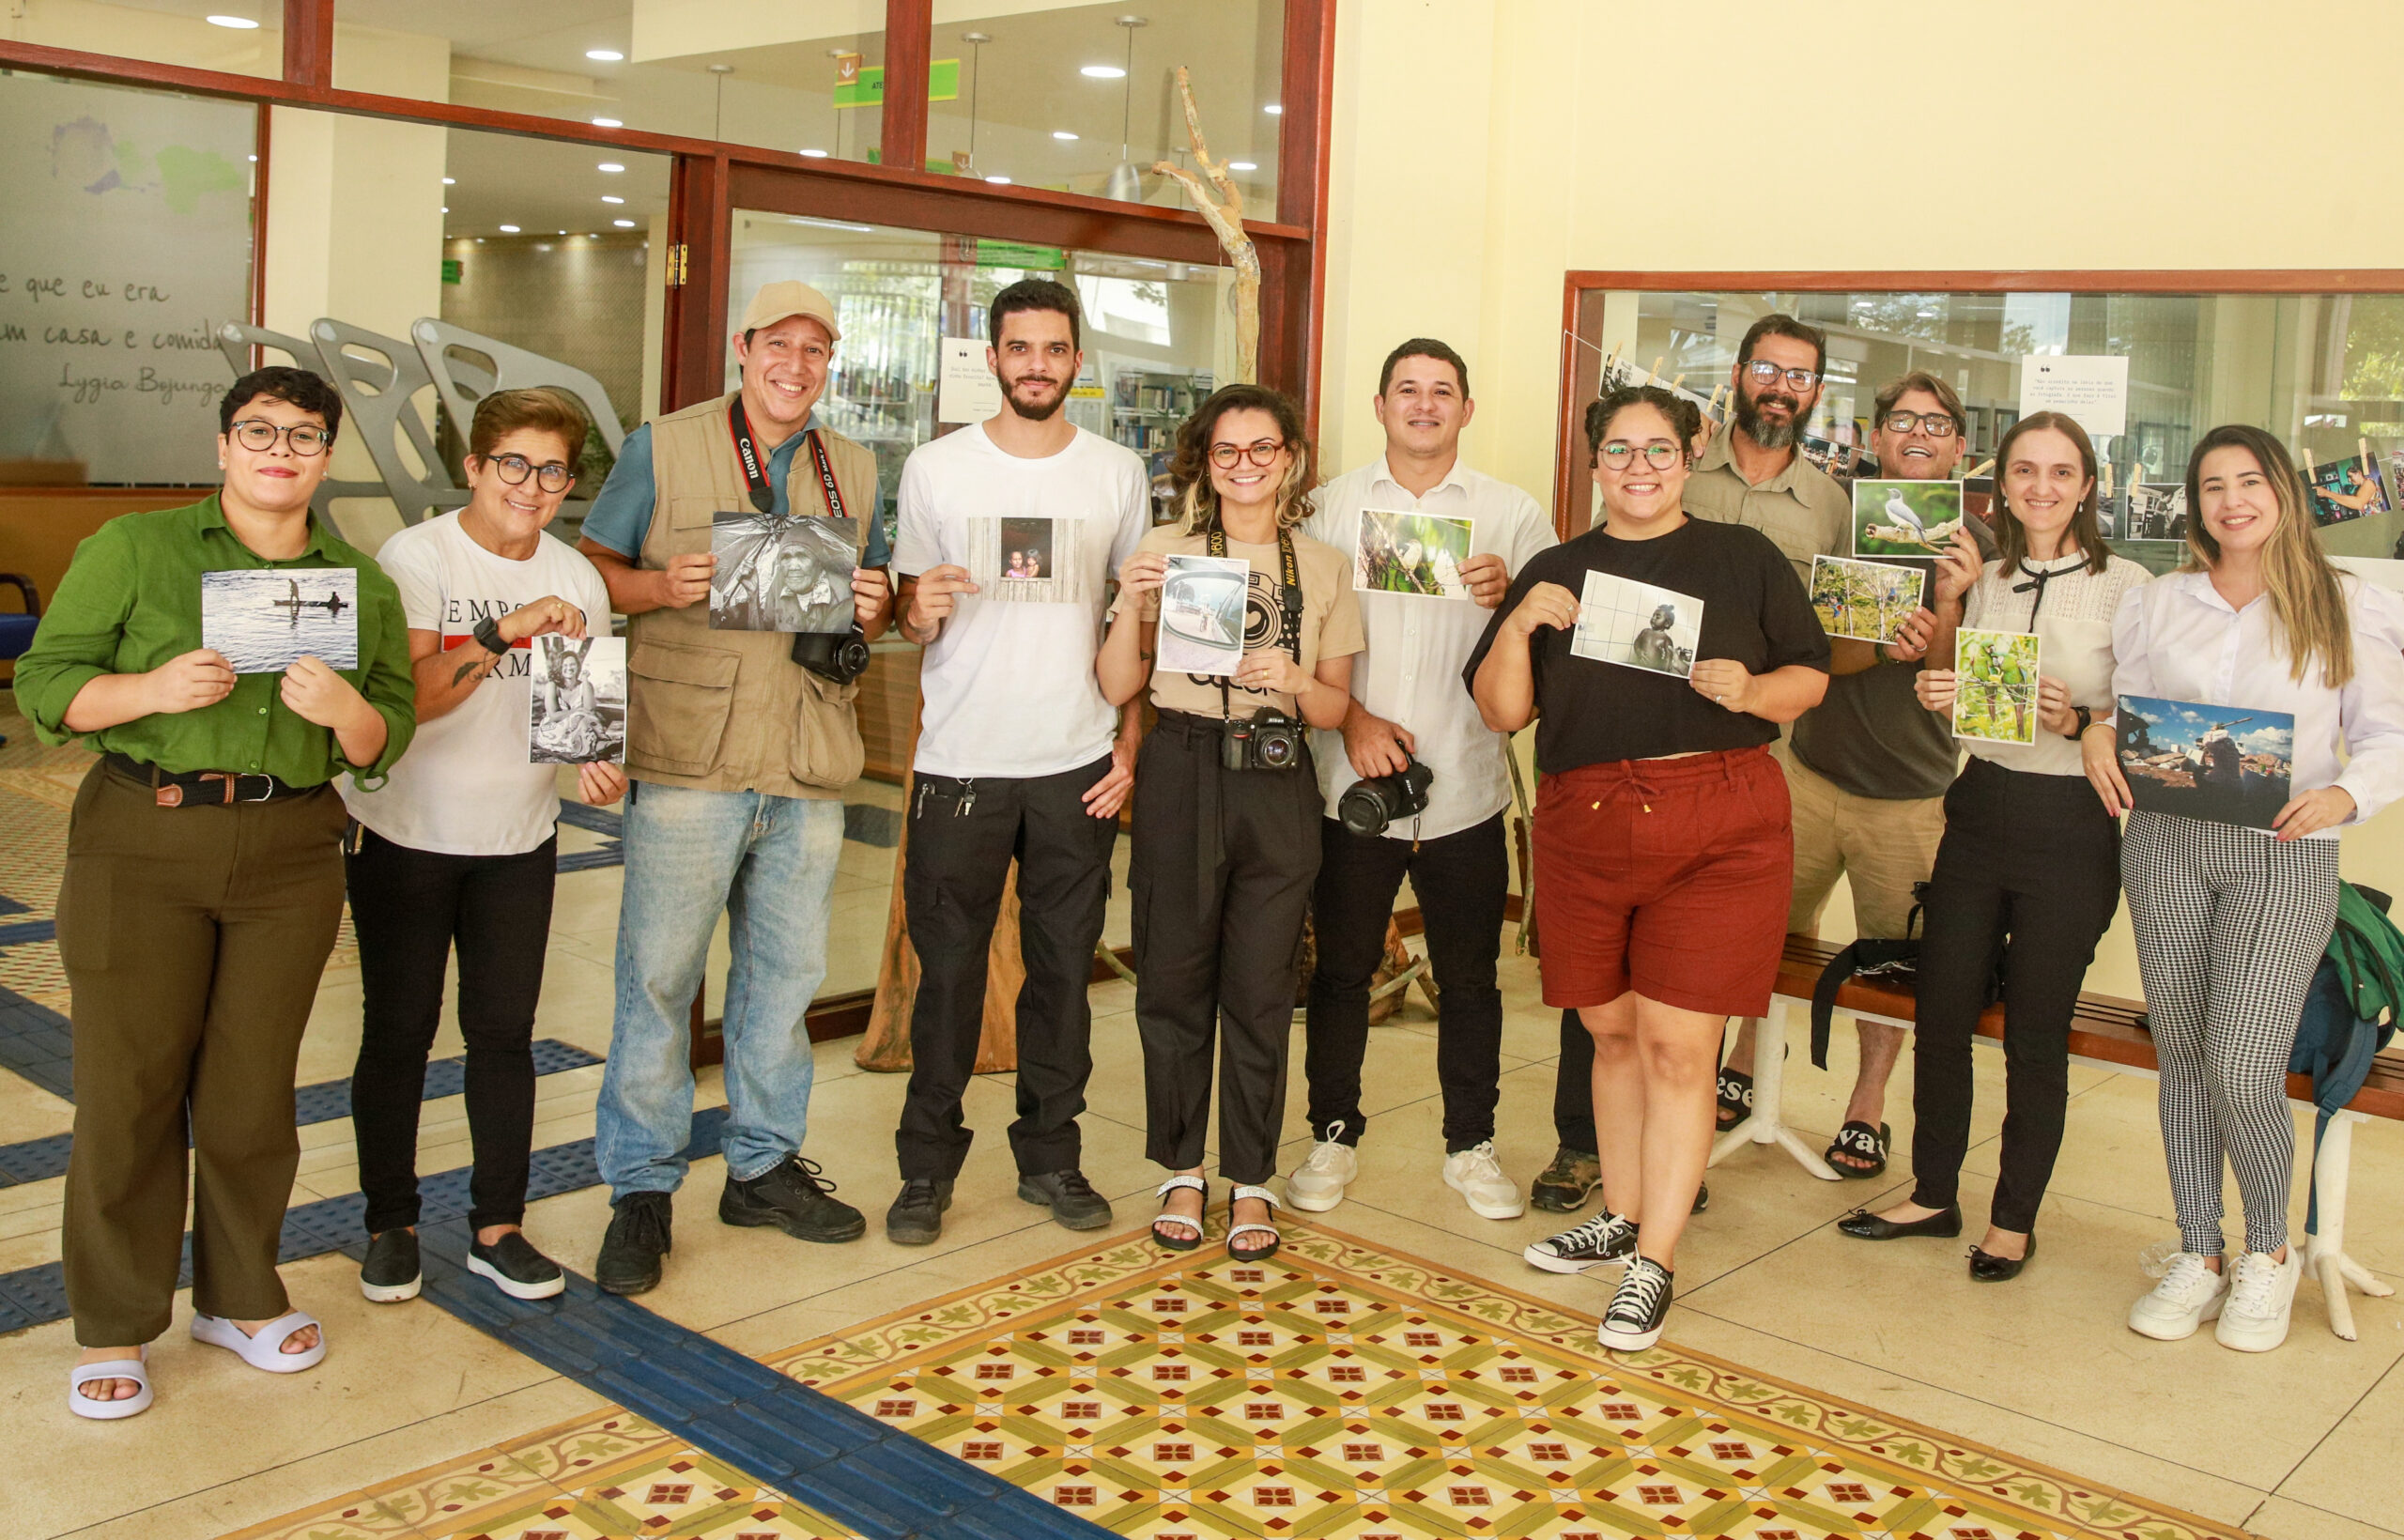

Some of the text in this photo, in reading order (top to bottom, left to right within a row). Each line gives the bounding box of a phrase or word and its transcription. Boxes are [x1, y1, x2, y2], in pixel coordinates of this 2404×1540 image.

[26, 277, 67, 302] que
[82, 280, 110, 299] eu
[124, 283, 170, 301] era
[44, 328, 112, 346] casa
[124, 331, 137, 348] e
[58, 363, 227, 408] Lygia Bojunga
[739, 438, 759, 479] Canon
[823, 473, 834, 488] 6D
[827, 490, 842, 517] EOS
[1285, 554, 1296, 586] Nikon
